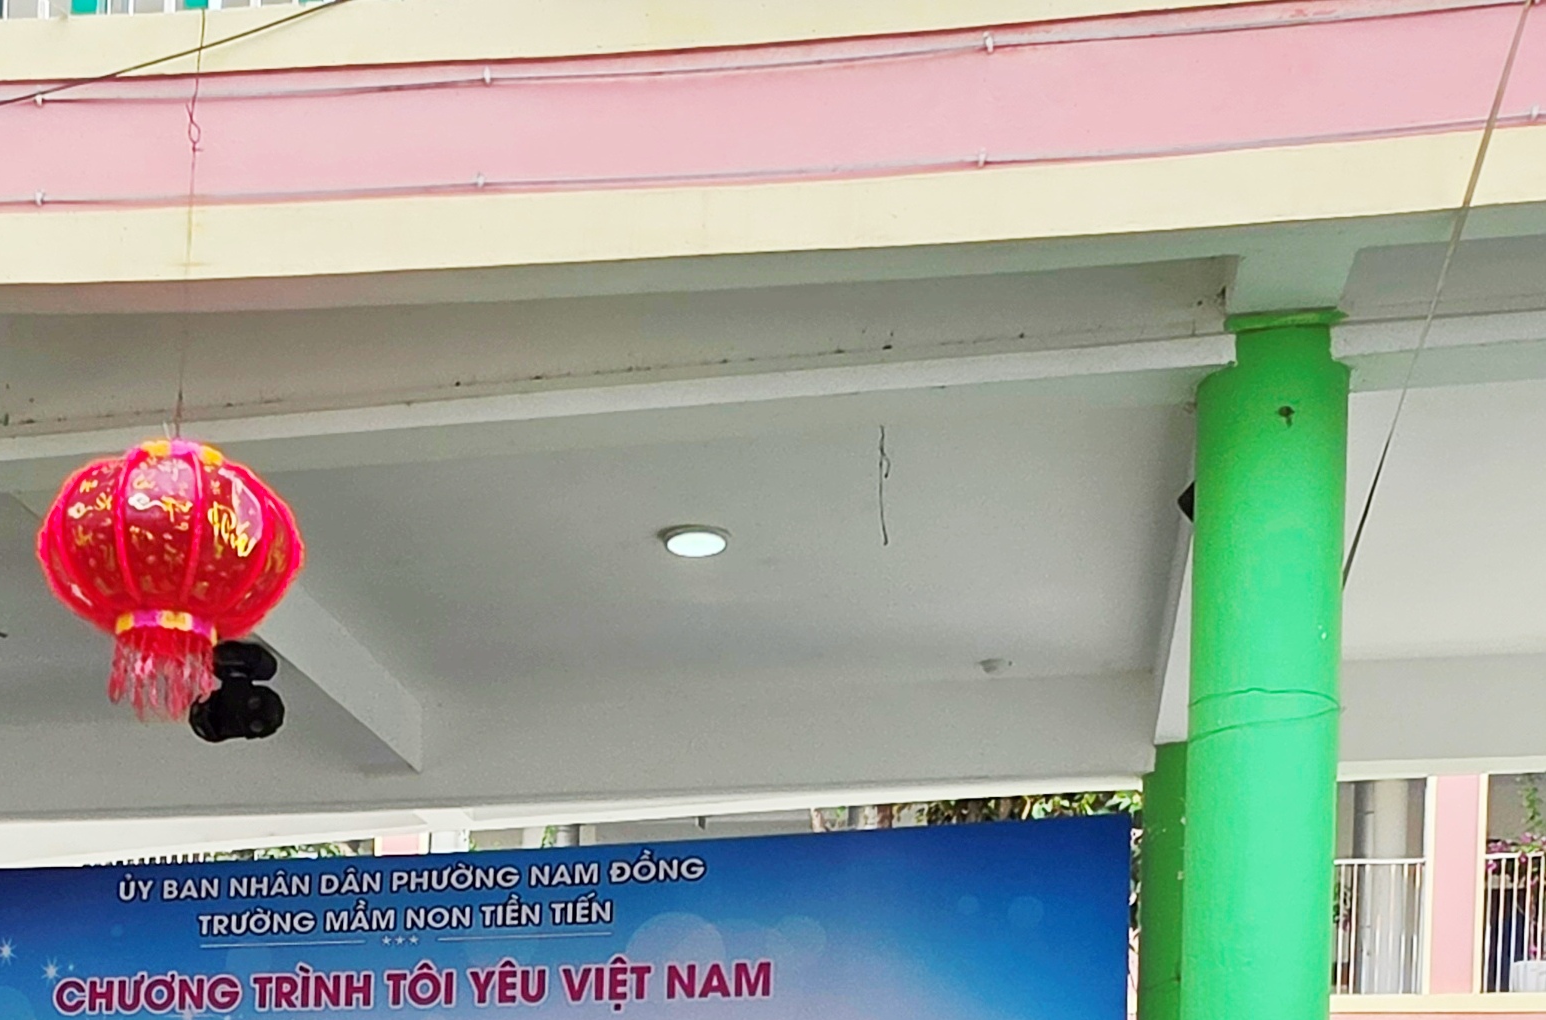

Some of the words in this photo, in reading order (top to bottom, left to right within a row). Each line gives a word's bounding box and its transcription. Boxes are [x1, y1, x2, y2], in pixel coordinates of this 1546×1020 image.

[118, 872, 154, 901] ỦY
[161, 877, 219, 900] BAN
[229, 869, 311, 898] NHÂN
[319, 868, 382, 895] DÂN
[391, 863, 521, 892] PHƯỜNG
[530, 862, 600, 887] NAM
[610, 849, 707, 883] ĐỒNG
[198, 907, 316, 936] TRƯỜNG
[324, 899, 396, 932] MẦM
[405, 905, 472, 930] NON
[550, 891, 613, 925] TIẾN
[54, 969, 242, 1014] CHƯƠNG
[252, 963, 373, 1010] TRÌNH
[385, 960, 455, 1007] TÔI
[469, 959, 547, 1006] YÊU
[562, 956, 653, 1012] VIỆT
[666, 960, 773, 1001] NAM
